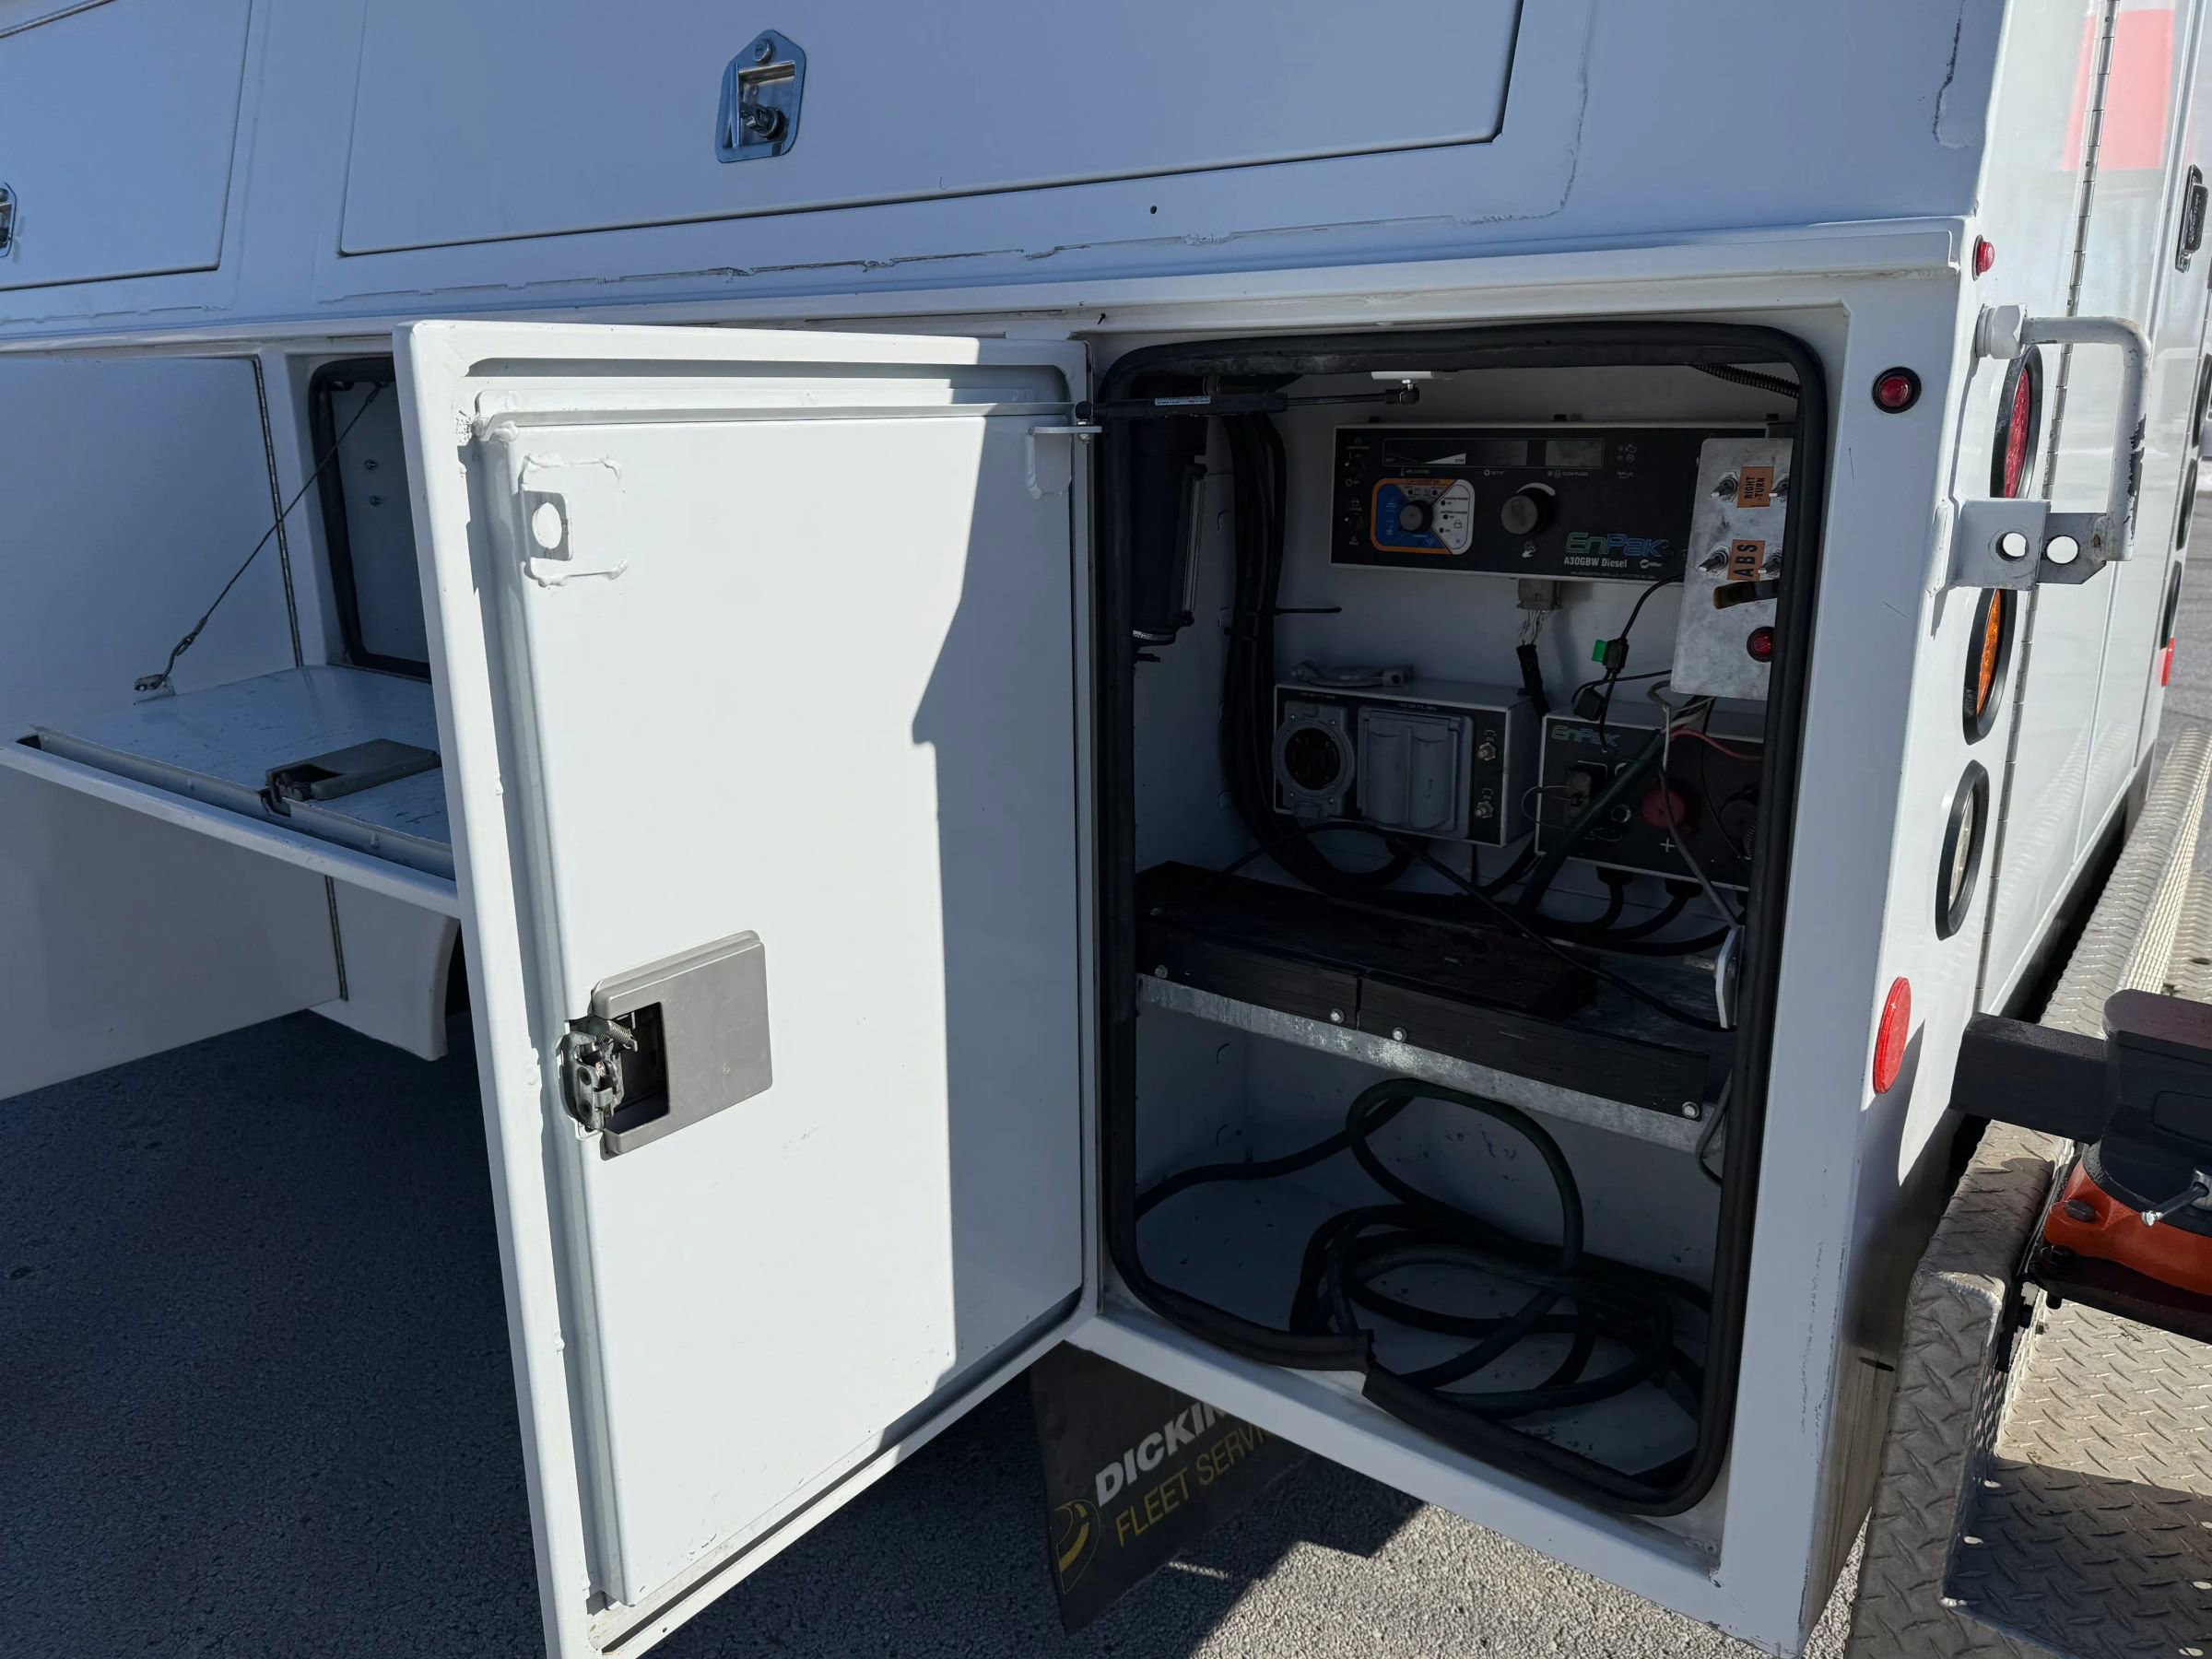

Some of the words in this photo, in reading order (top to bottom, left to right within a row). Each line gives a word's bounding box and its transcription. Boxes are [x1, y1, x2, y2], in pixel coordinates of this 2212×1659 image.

[1744, 477, 1755, 500] RIGHT
[1755, 477, 1765, 498] TURN
[1563, 556, 1599, 567] A30GBW
[1601, 558, 1628, 569] Diesel
[1734, 544, 1758, 578] ABS
[1114, 1466, 1190, 1547] FLEET
[1195, 1425, 1271, 1485] SERVI
